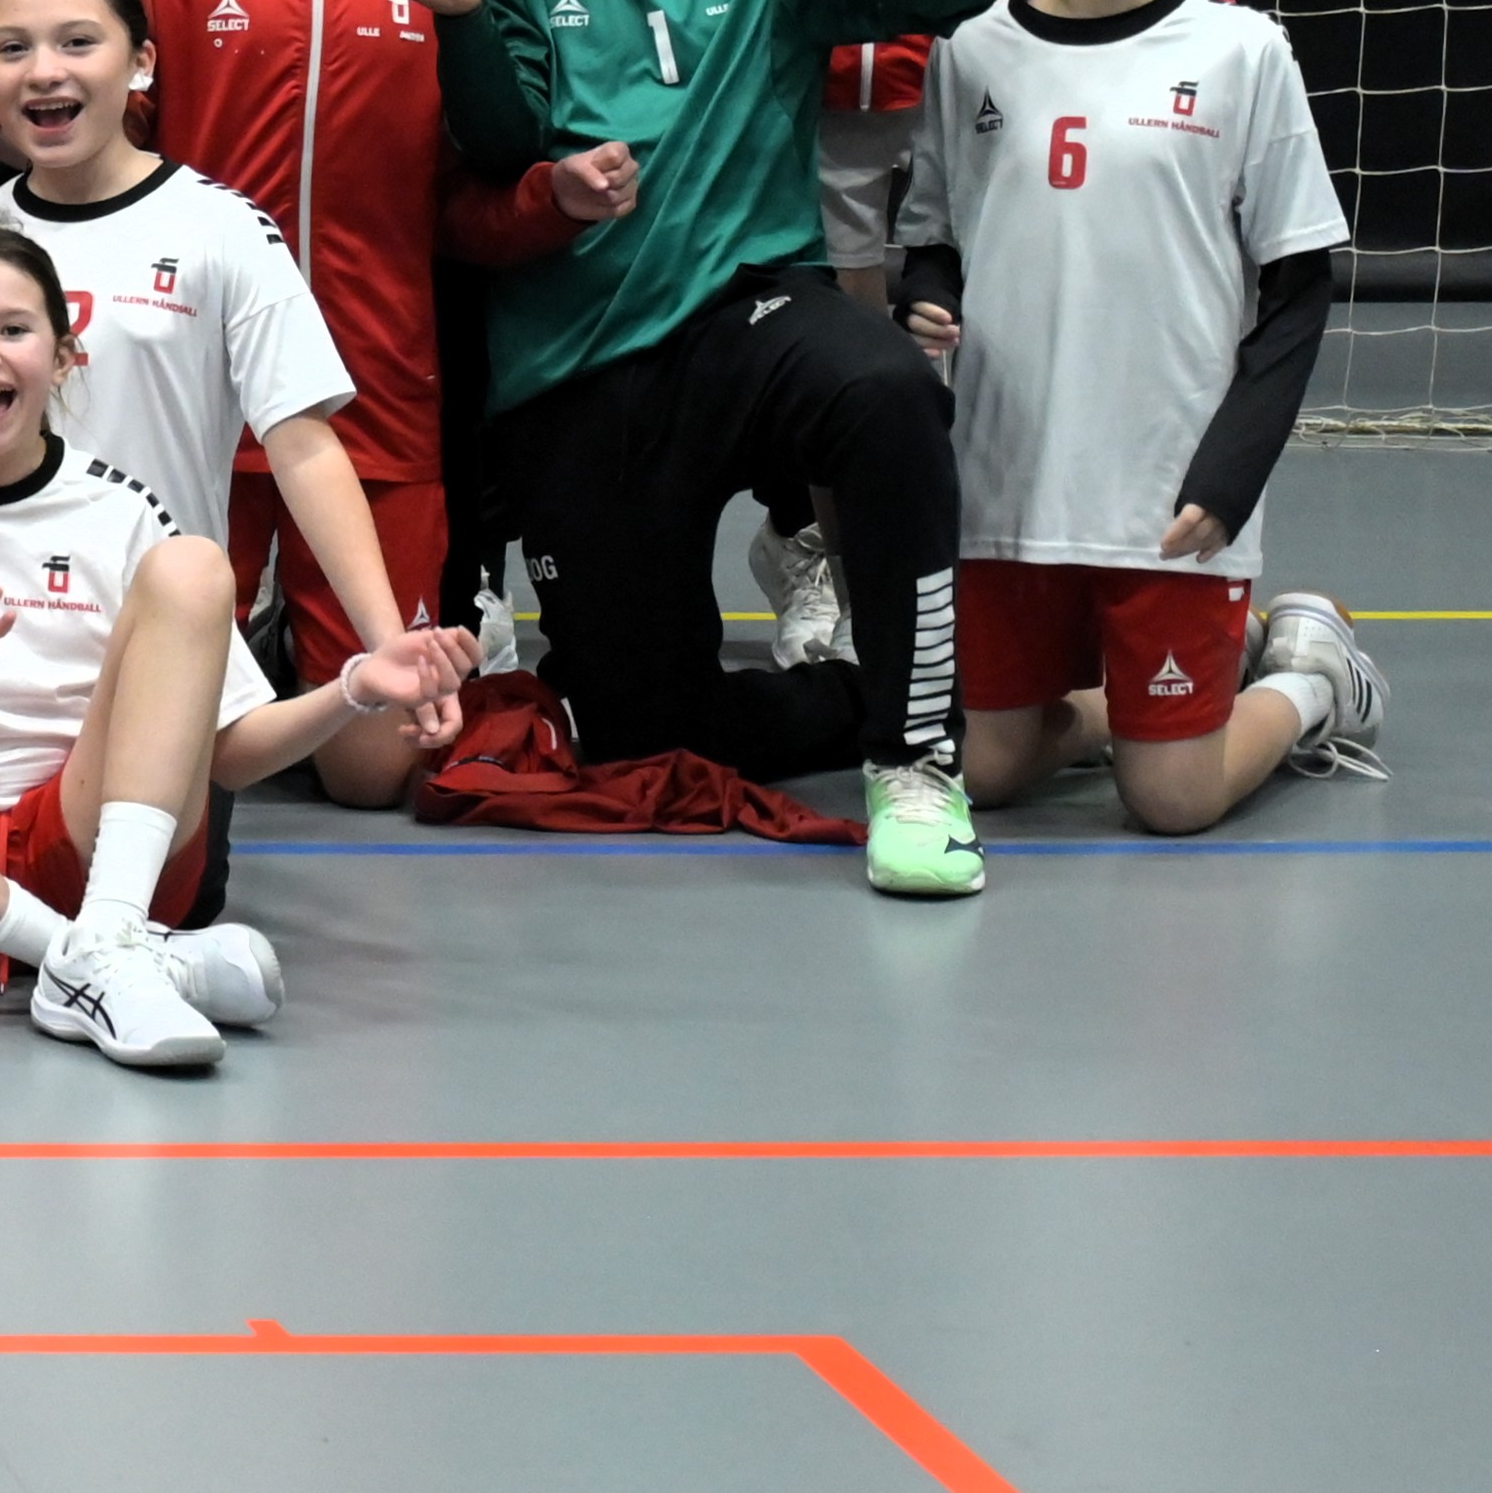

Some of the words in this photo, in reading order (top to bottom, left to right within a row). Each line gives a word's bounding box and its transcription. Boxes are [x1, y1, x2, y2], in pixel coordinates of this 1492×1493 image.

[207, 19, 250, 32] SELECT
[550, 14, 590, 28] SELECT
[647, 10, 679, 85] 1
[1129, 117, 1168, 129] ULLERN
[1171, 119, 1220, 139] HÅNDBALL
[1048, 116, 1087, 190] 6
[113, 295, 149, 306] ULLERN
[152, 298, 198, 317] HÅNDBALL
[4, 597, 44, 609] ULLERN
[48, 593, 101, 613] HÅNDBALL
[1148, 682, 1193, 696] SELECT
